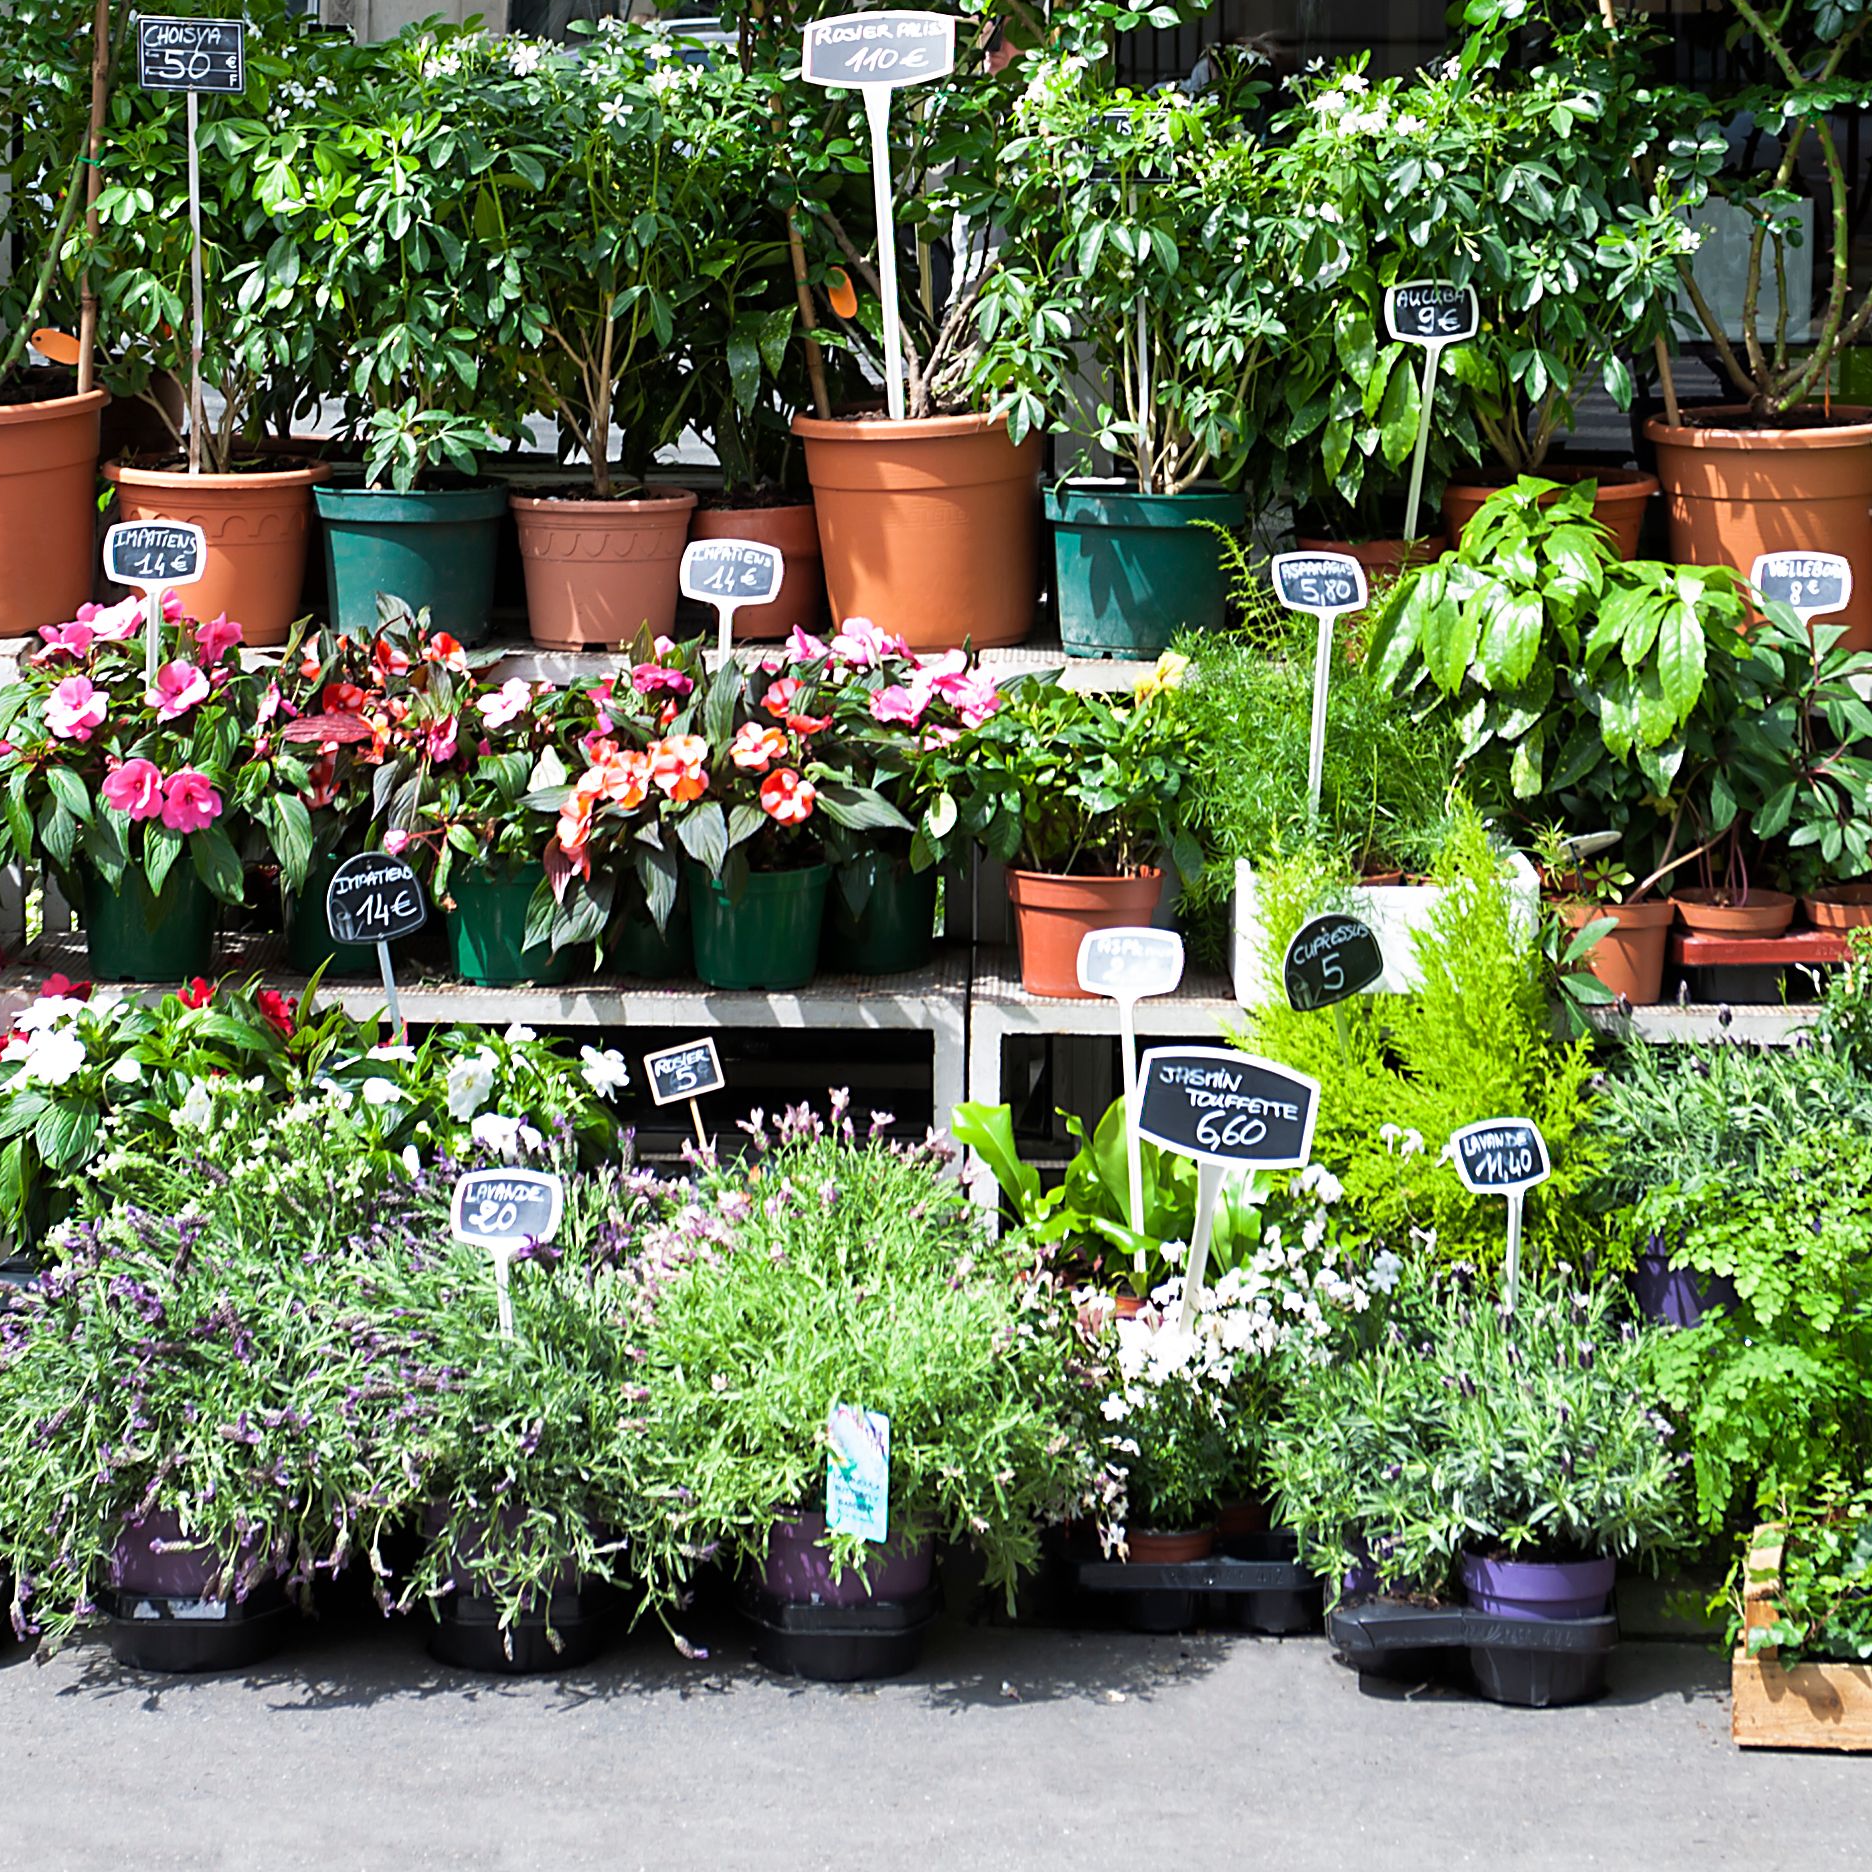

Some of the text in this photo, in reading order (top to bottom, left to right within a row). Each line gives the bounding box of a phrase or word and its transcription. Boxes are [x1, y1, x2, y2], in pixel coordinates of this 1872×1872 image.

[144, 25, 222, 52] CHOISYA
[159, 50, 211, 80] 50
[114, 528, 197, 555] IMPATIENS
[1293, 923, 1369, 965] CUPRESSUS
[1321, 952, 1344, 990] 5
[654, 1048, 710, 1077] ROSIER
[1159, 1067, 1242, 1092] JASMIN
[1185, 1087, 1299, 1121] TOUFFETTE
[1196, 1110, 1267, 1152] 6,60
[1463, 1131, 1528, 1157] LAVANDE
[465, 1182, 544, 1203] LAVANDE
